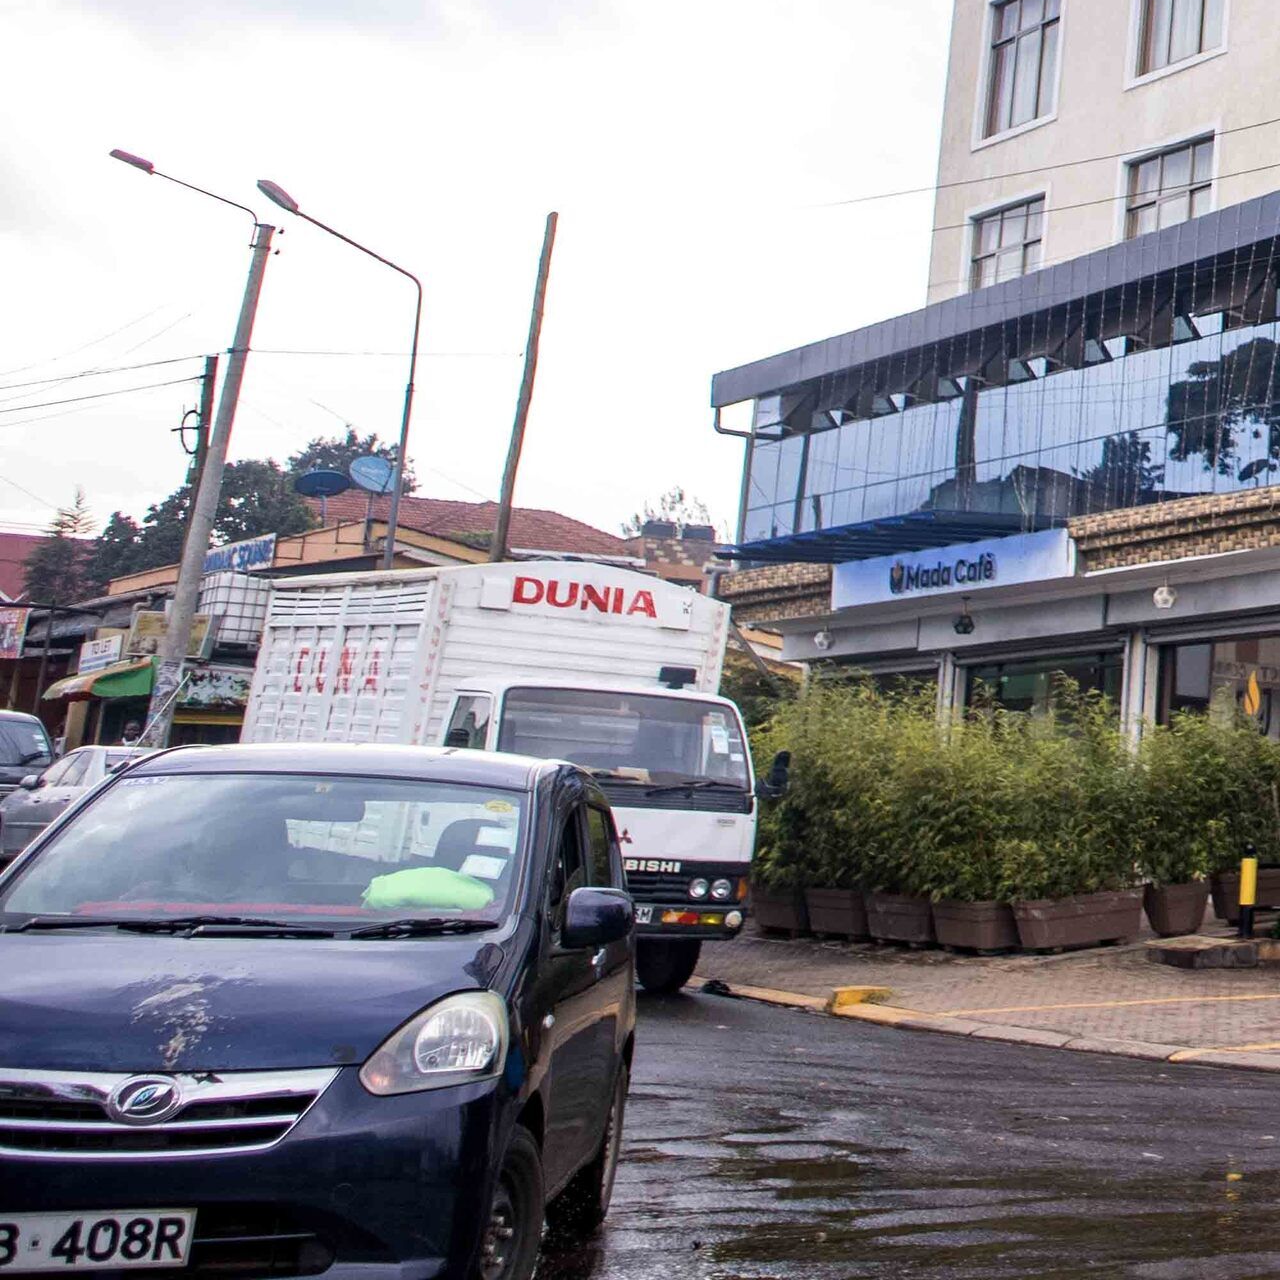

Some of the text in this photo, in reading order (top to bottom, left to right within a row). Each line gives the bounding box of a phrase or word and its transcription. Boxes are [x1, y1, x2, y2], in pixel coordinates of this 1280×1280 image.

[906, 562, 951, 590] Mada
[512, 577, 657, 618] DUNIA
[622, 860, 681, 873] BISHI
[51, 1217, 186, 1264] 408R
